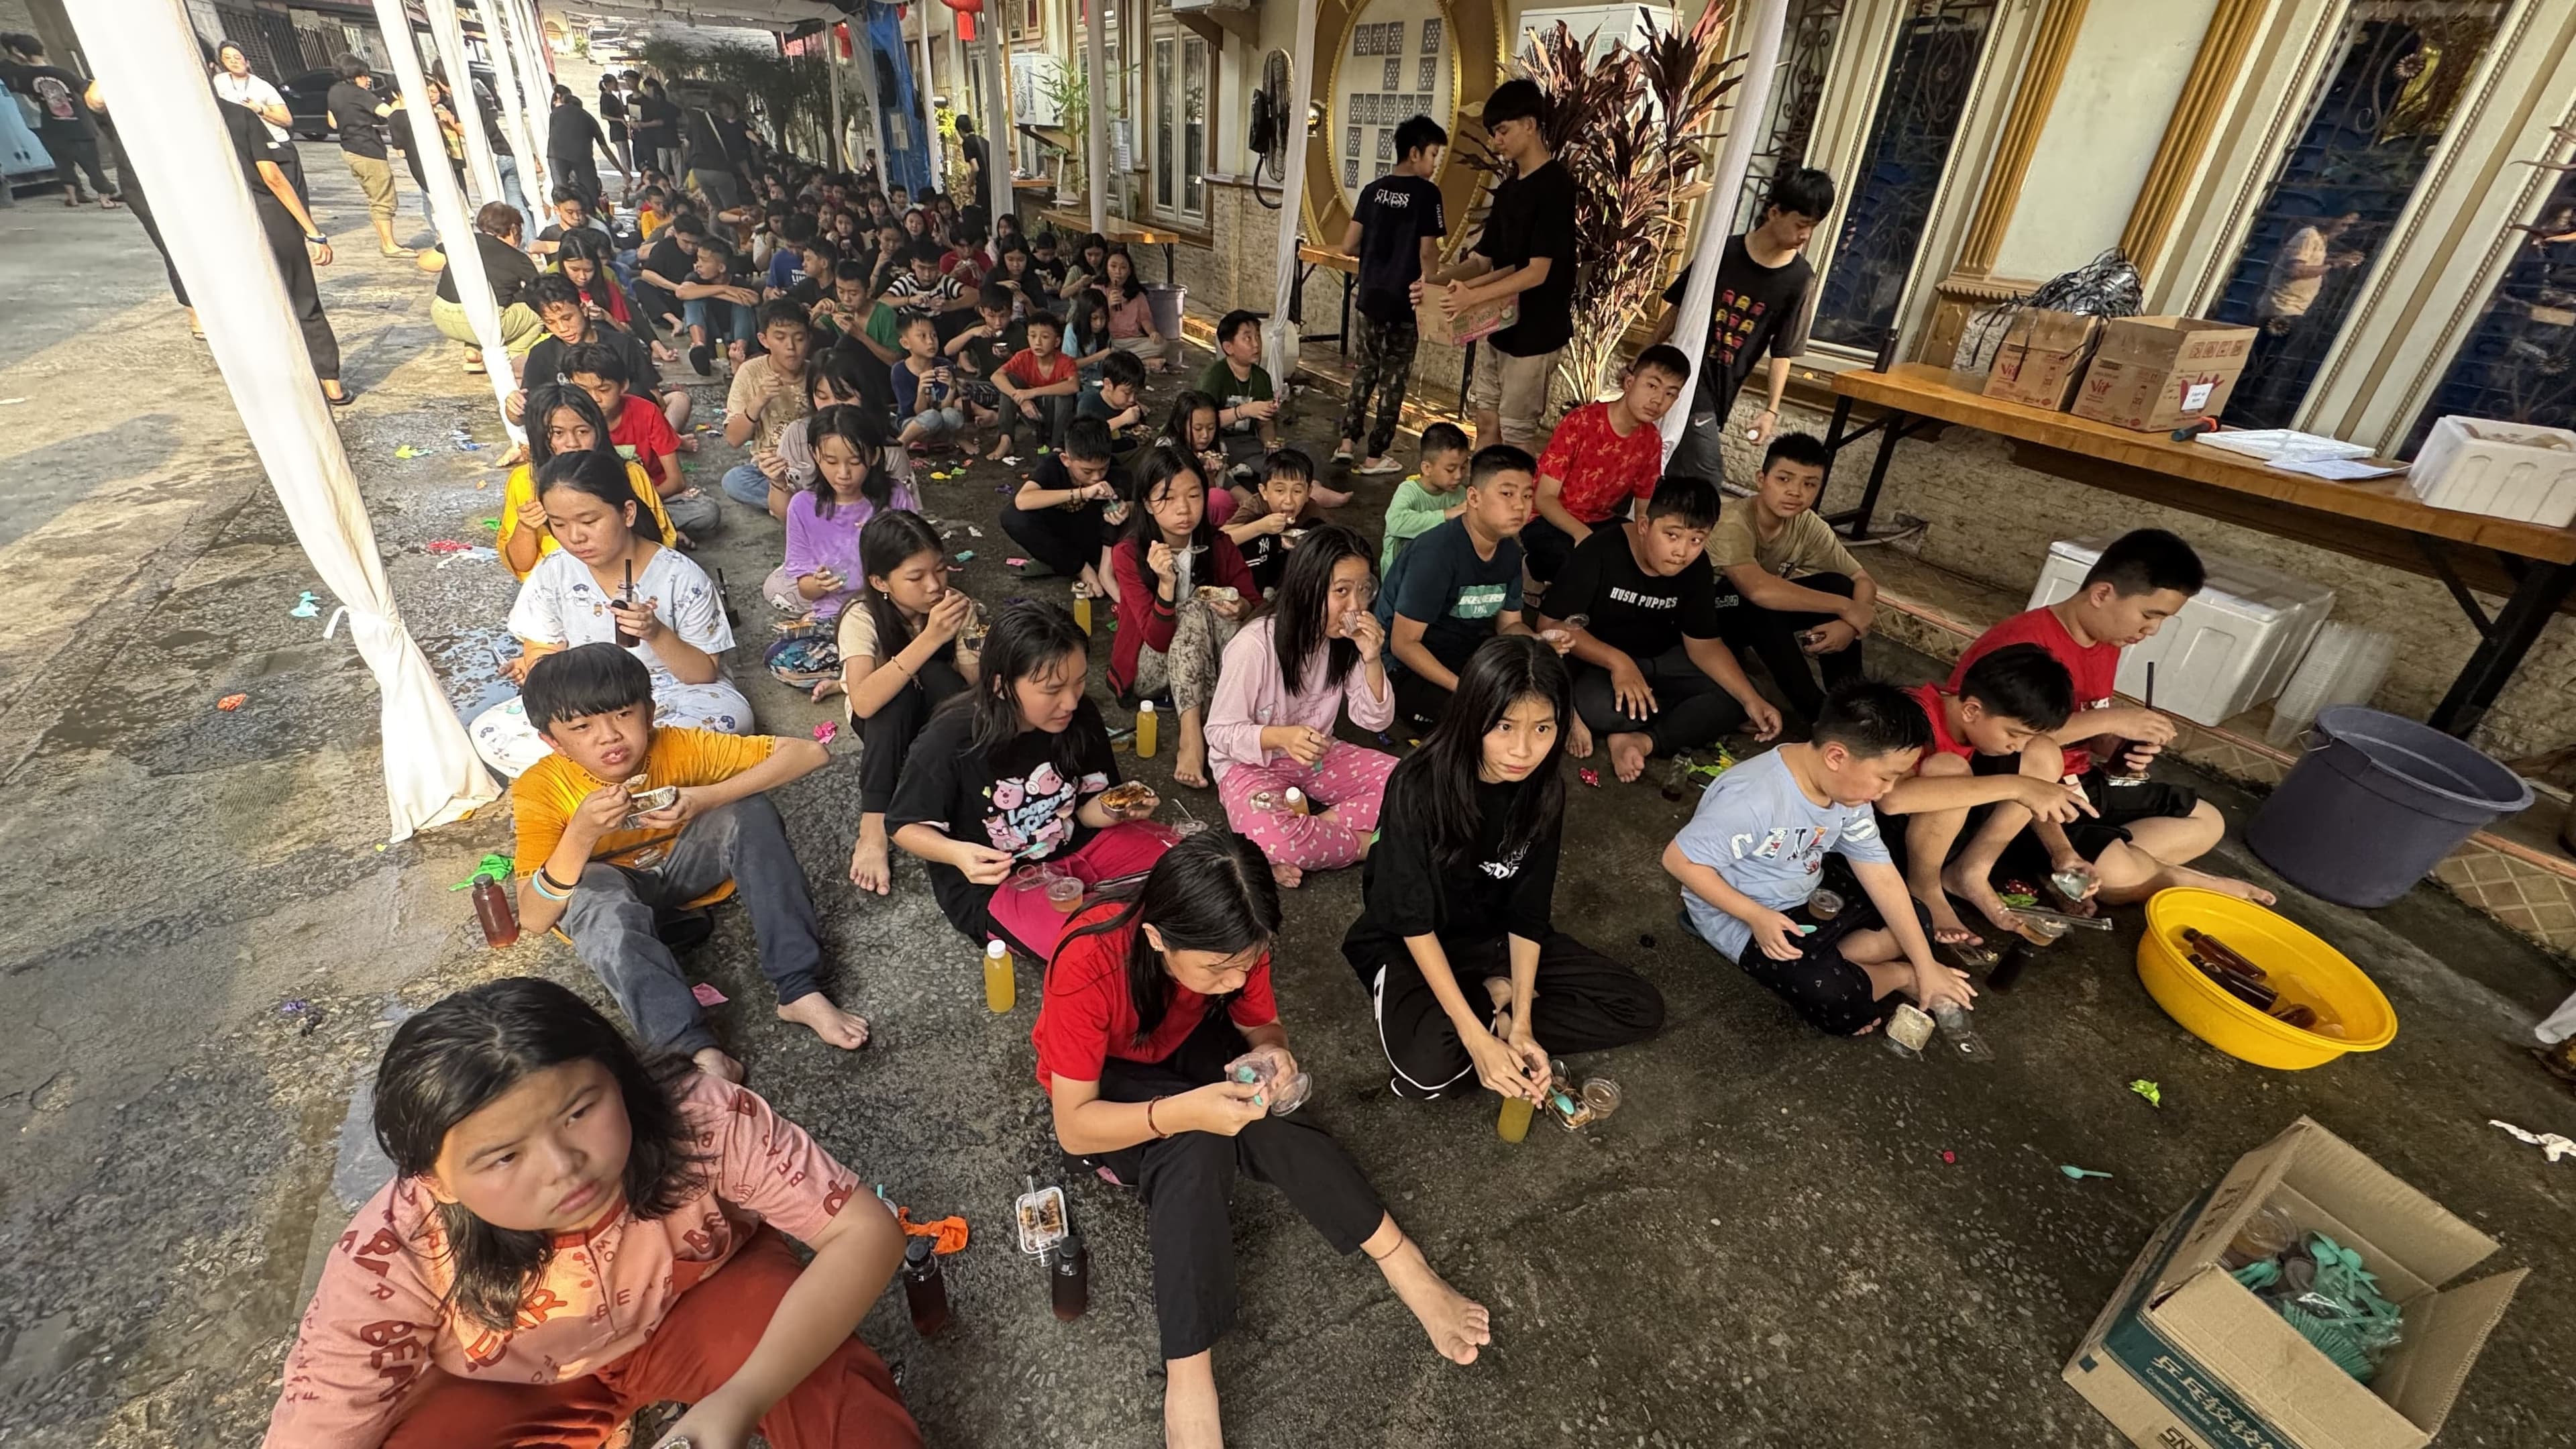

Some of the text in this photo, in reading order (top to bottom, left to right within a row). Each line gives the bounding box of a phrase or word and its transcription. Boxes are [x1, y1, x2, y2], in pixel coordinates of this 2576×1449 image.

[1375, 189, 1410, 208] GUESS
[2091, 378, 2112, 395] Vit
[1610, 587, 1678, 610] HUSH PUPPES
[582, 771, 616, 788] FEND
